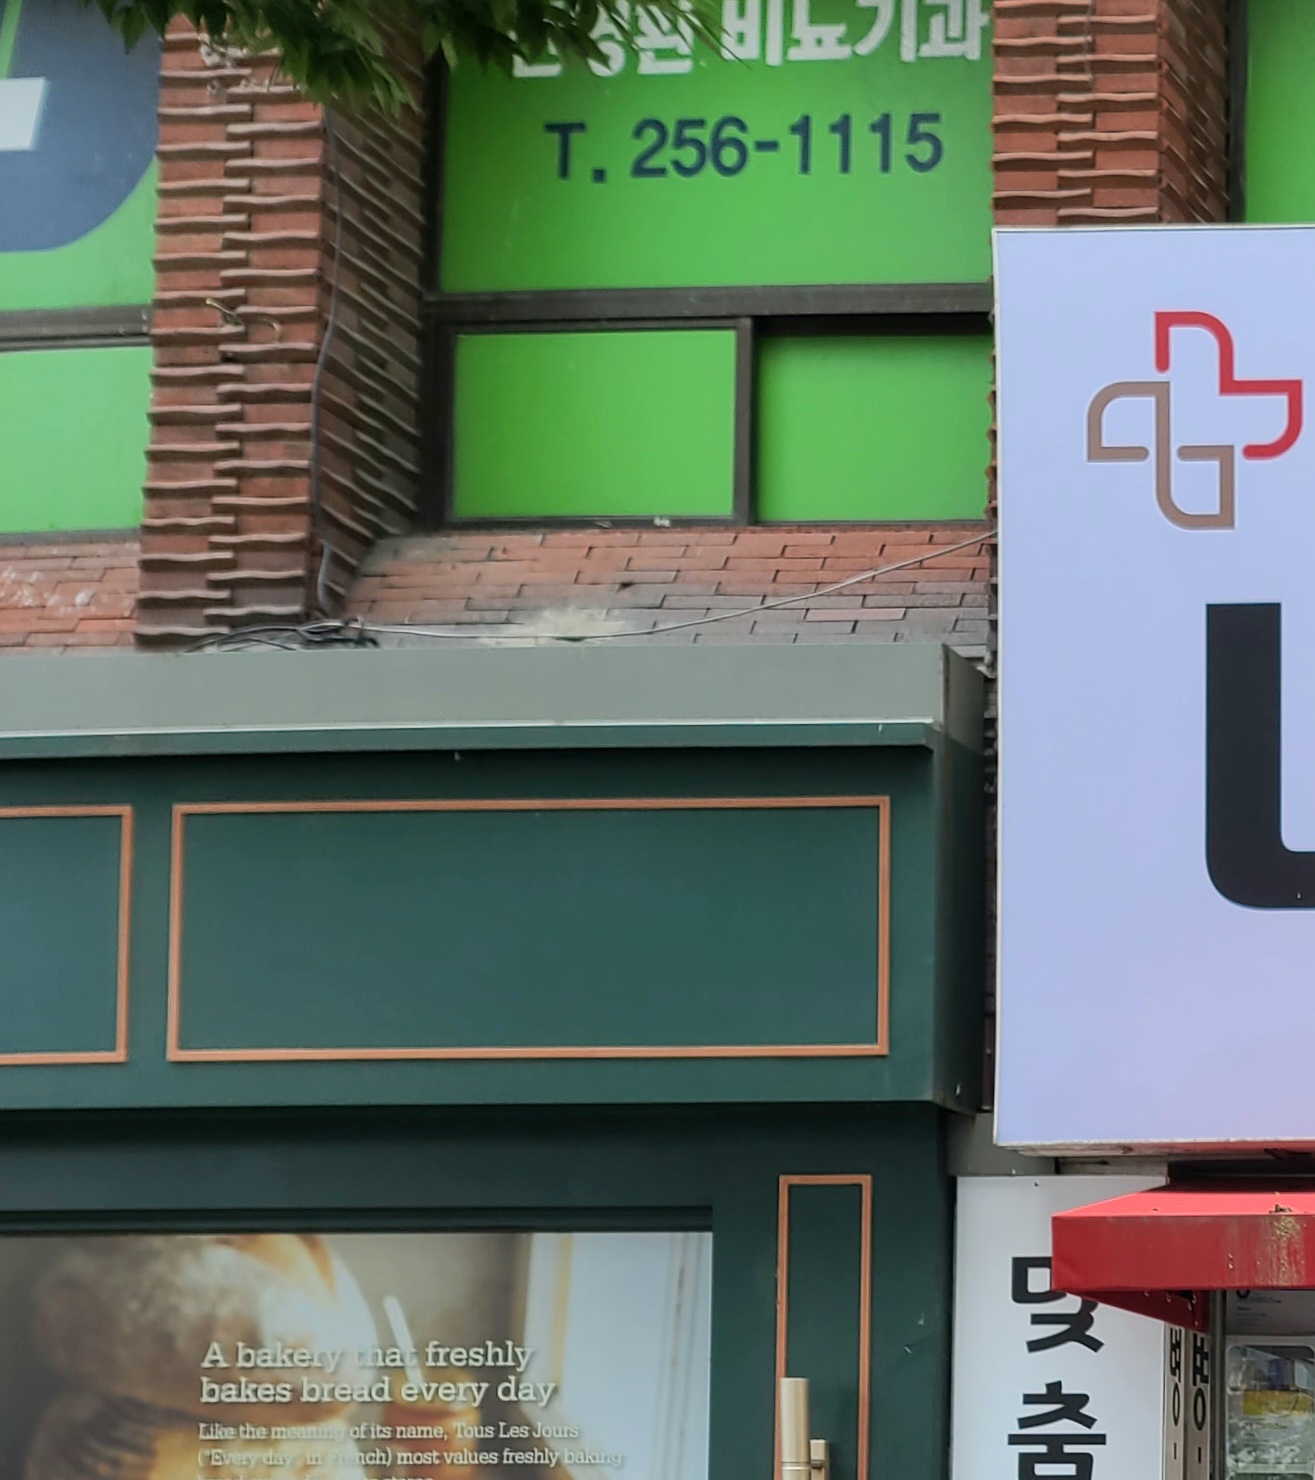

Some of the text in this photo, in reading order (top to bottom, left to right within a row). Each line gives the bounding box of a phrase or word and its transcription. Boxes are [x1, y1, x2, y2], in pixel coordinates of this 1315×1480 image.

[543, 112, 944, 184] T. 256-1115
[200, 1340, 532, 1374] A bakery that freshly
[200, 1376, 556, 1408] bakes bread every day
[198, 1422, 579, 1443] Like the meaning of its name, Tous Les Jours
[397, 1450, 439, 1465] most
[444, 1448, 498, 1465] values
[502, 1448, 560, 1467] freshly
[563, 1448, 623, 1467] baking
